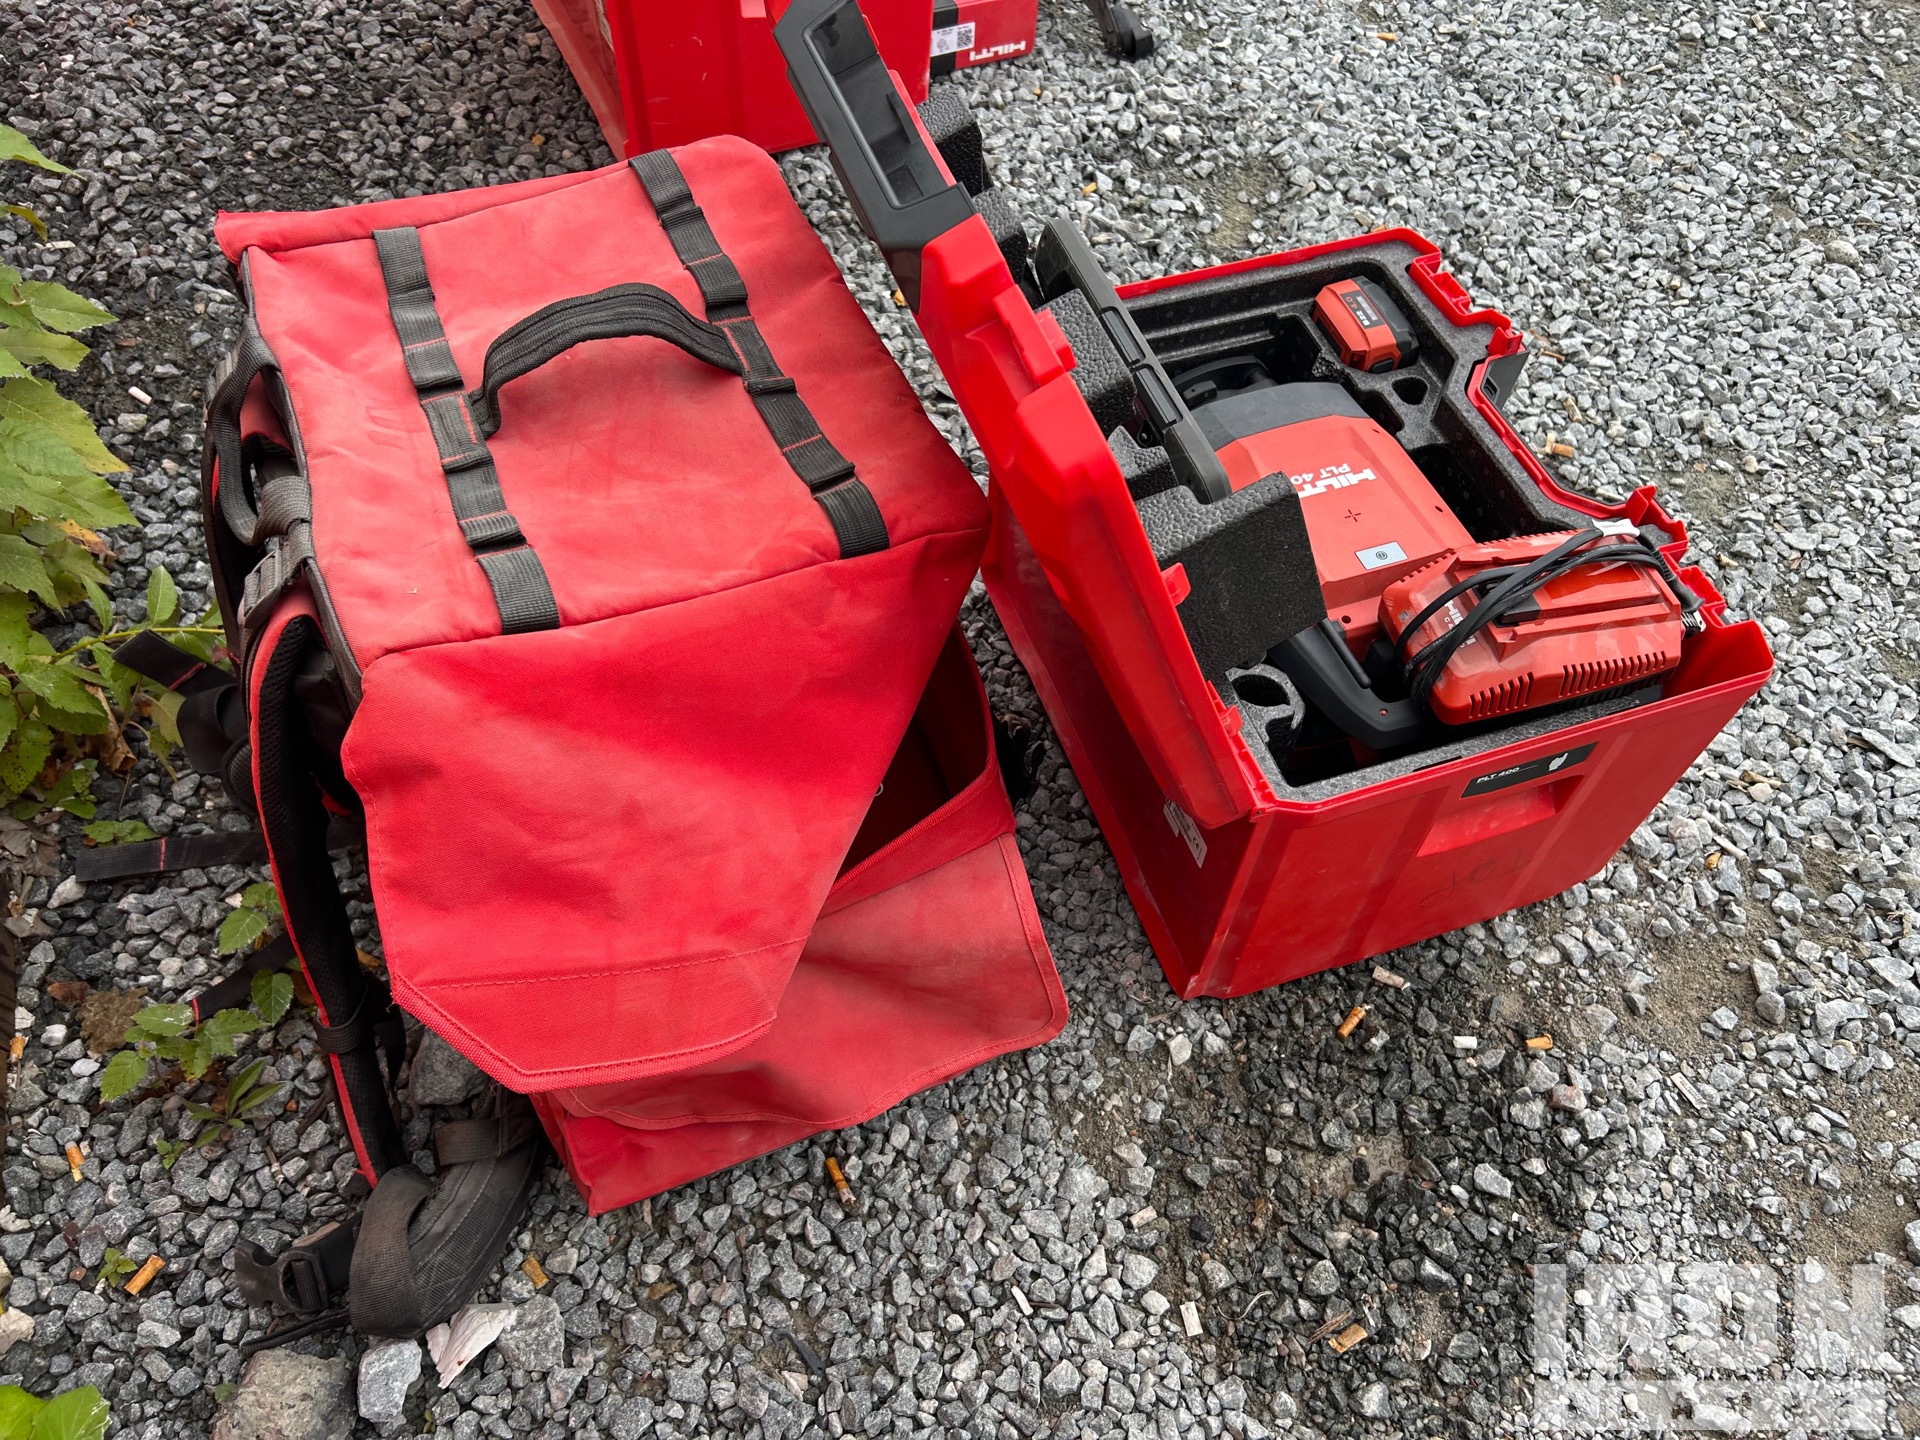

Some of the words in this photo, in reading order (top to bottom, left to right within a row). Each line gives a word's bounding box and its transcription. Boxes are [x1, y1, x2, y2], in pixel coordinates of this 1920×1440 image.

[968, 41, 1026, 61] HILTI
[1356, 310, 1370, 326] B22
[1290, 472, 1314, 485] 40
[1320, 463, 1351, 478] PLT
[1298, 468, 1376, 498] HILT
[1444, 600, 1476, 645] HILI
[1476, 773, 1497, 784] PLT
[1498, 767, 1520, 777] 400
